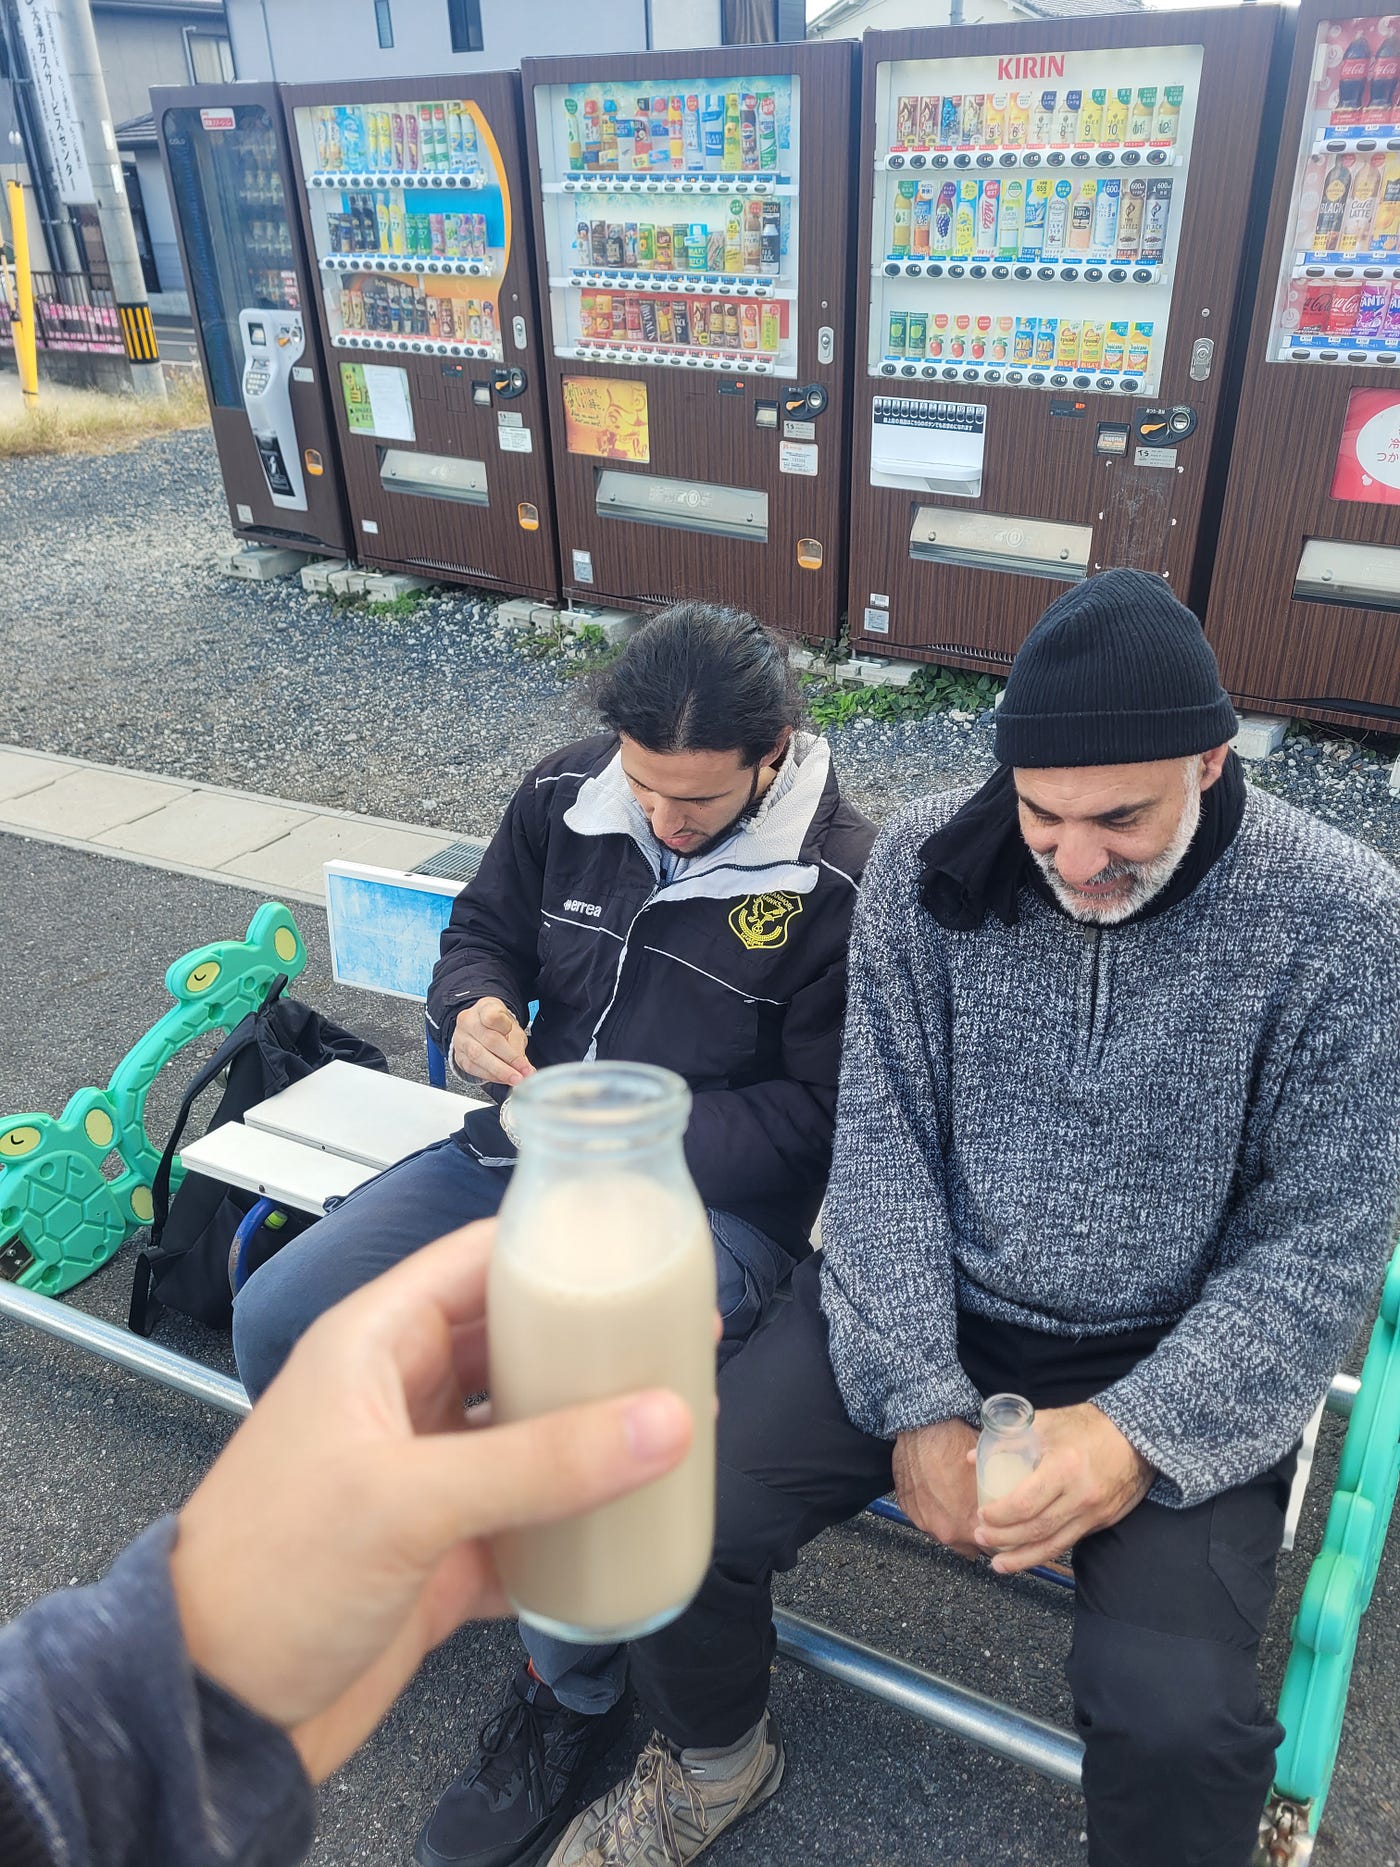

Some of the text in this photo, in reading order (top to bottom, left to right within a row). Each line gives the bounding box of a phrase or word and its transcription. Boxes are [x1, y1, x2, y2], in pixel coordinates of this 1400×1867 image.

[998, 55, 1065, 80] KIRIN
[1107, 124, 1118, 136] 10
[1349, 209, 1371, 218] LATTE
[1376, 452, 1399, 463] つか
[571, 899, 602, 917] errea
